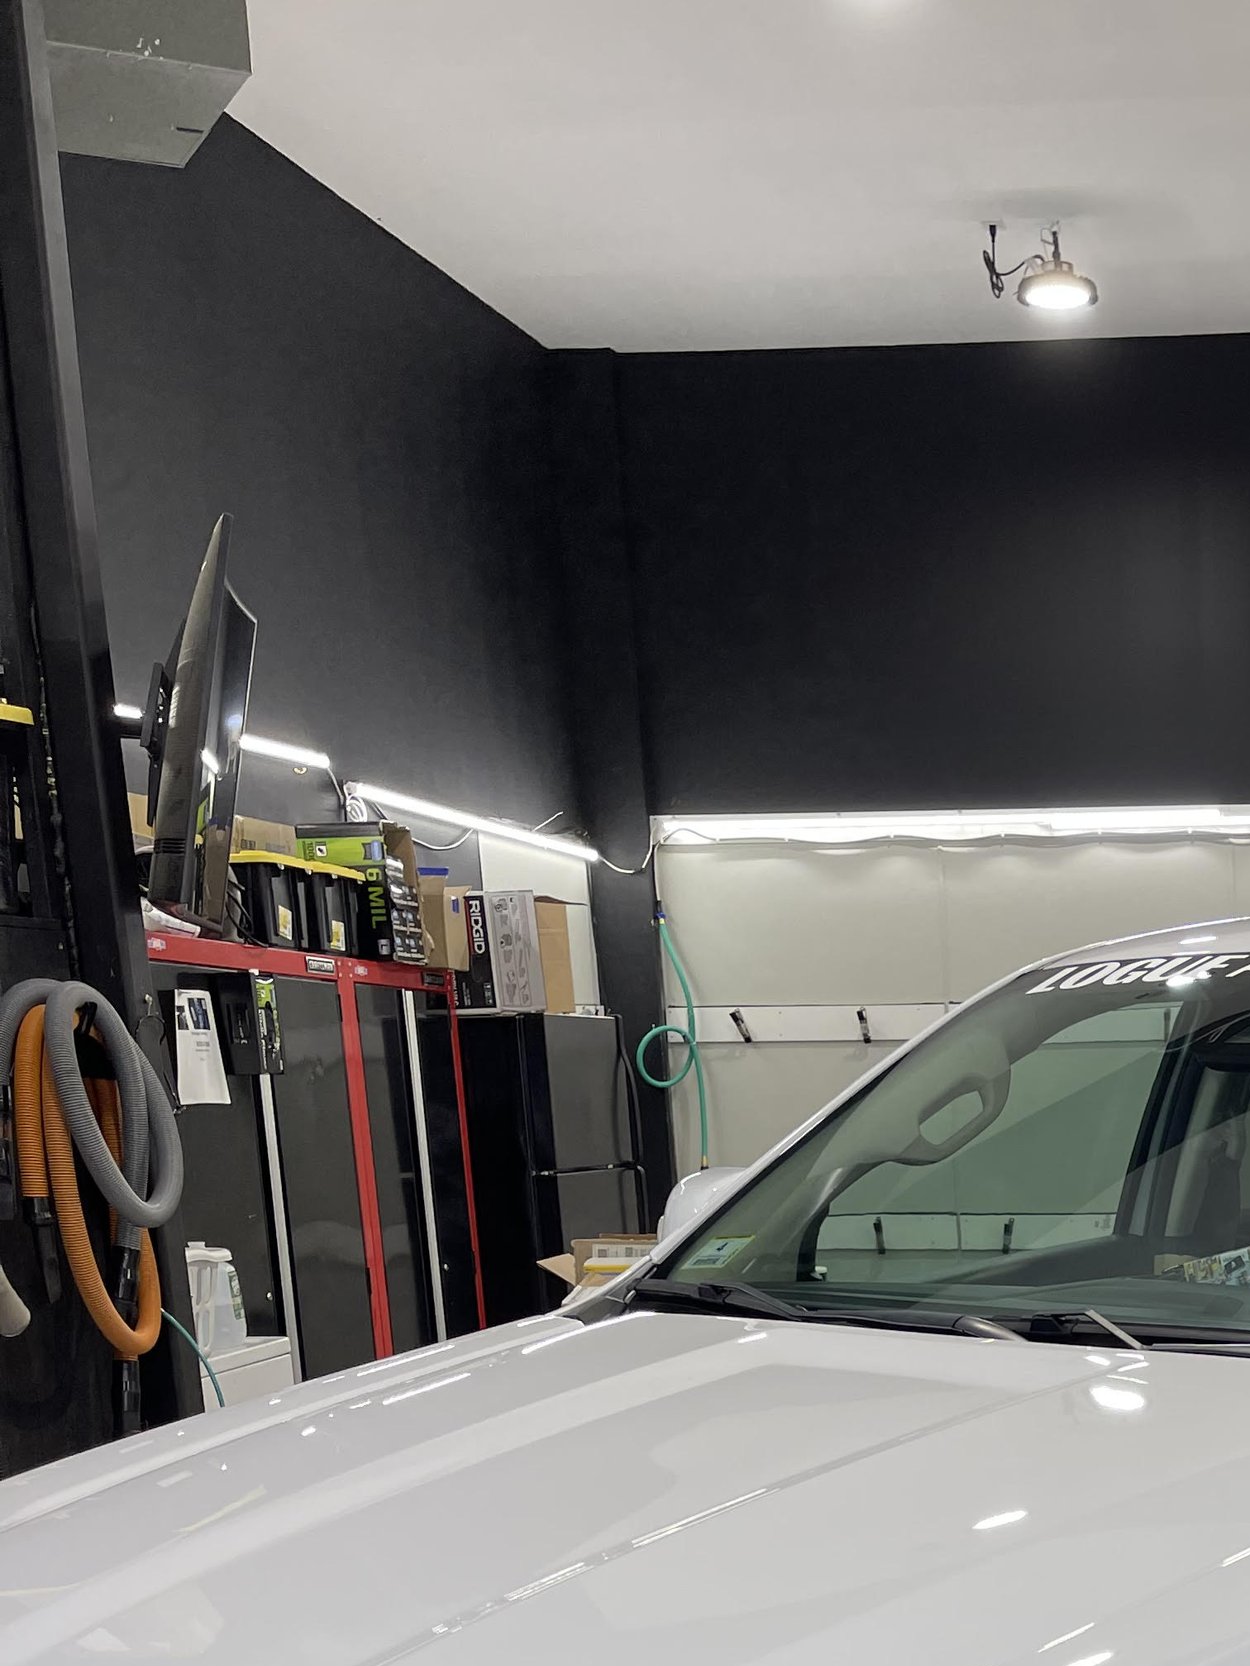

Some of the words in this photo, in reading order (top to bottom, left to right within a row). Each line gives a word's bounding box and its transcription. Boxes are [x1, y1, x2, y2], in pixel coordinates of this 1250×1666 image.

[367, 886, 388, 929] MIL
[469, 900, 485, 954] RIDGID
[1025, 953, 1249, 995] LOGUE
